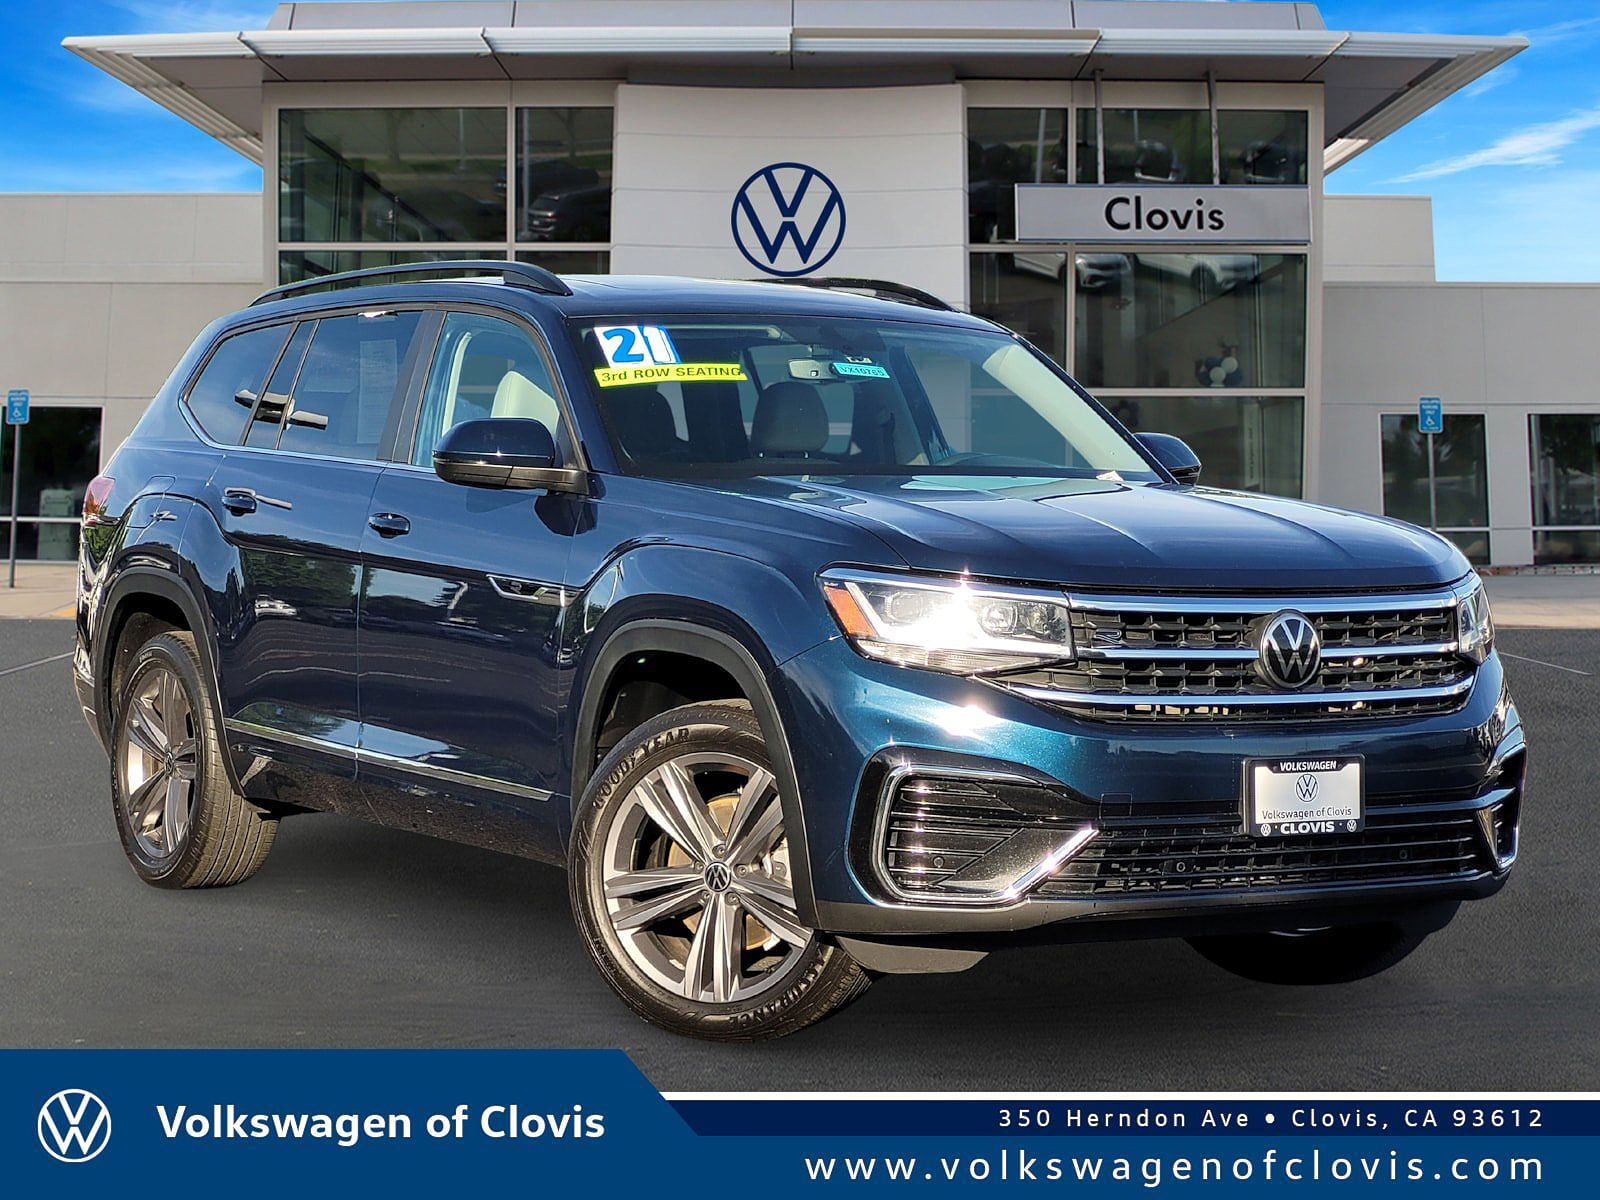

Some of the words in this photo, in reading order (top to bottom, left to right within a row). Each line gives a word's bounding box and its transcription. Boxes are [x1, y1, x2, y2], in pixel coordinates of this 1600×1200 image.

[1105, 196, 1224, 231] Clovis
[602, 326, 680, 364] 21
[602, 371, 627, 382] 3rd
[634, 368, 670, 379] ROW
[676, 367, 741, 377] SEATING
[1280, 761, 1337, 772] VOLKSWAGEN
[1262, 809, 1314, 820] Volkswagen
[1316, 807, 1325, 817] of
[1326, 806, 1352, 817] Clovis
[1280, 821, 1335, 835] CLOVIS
